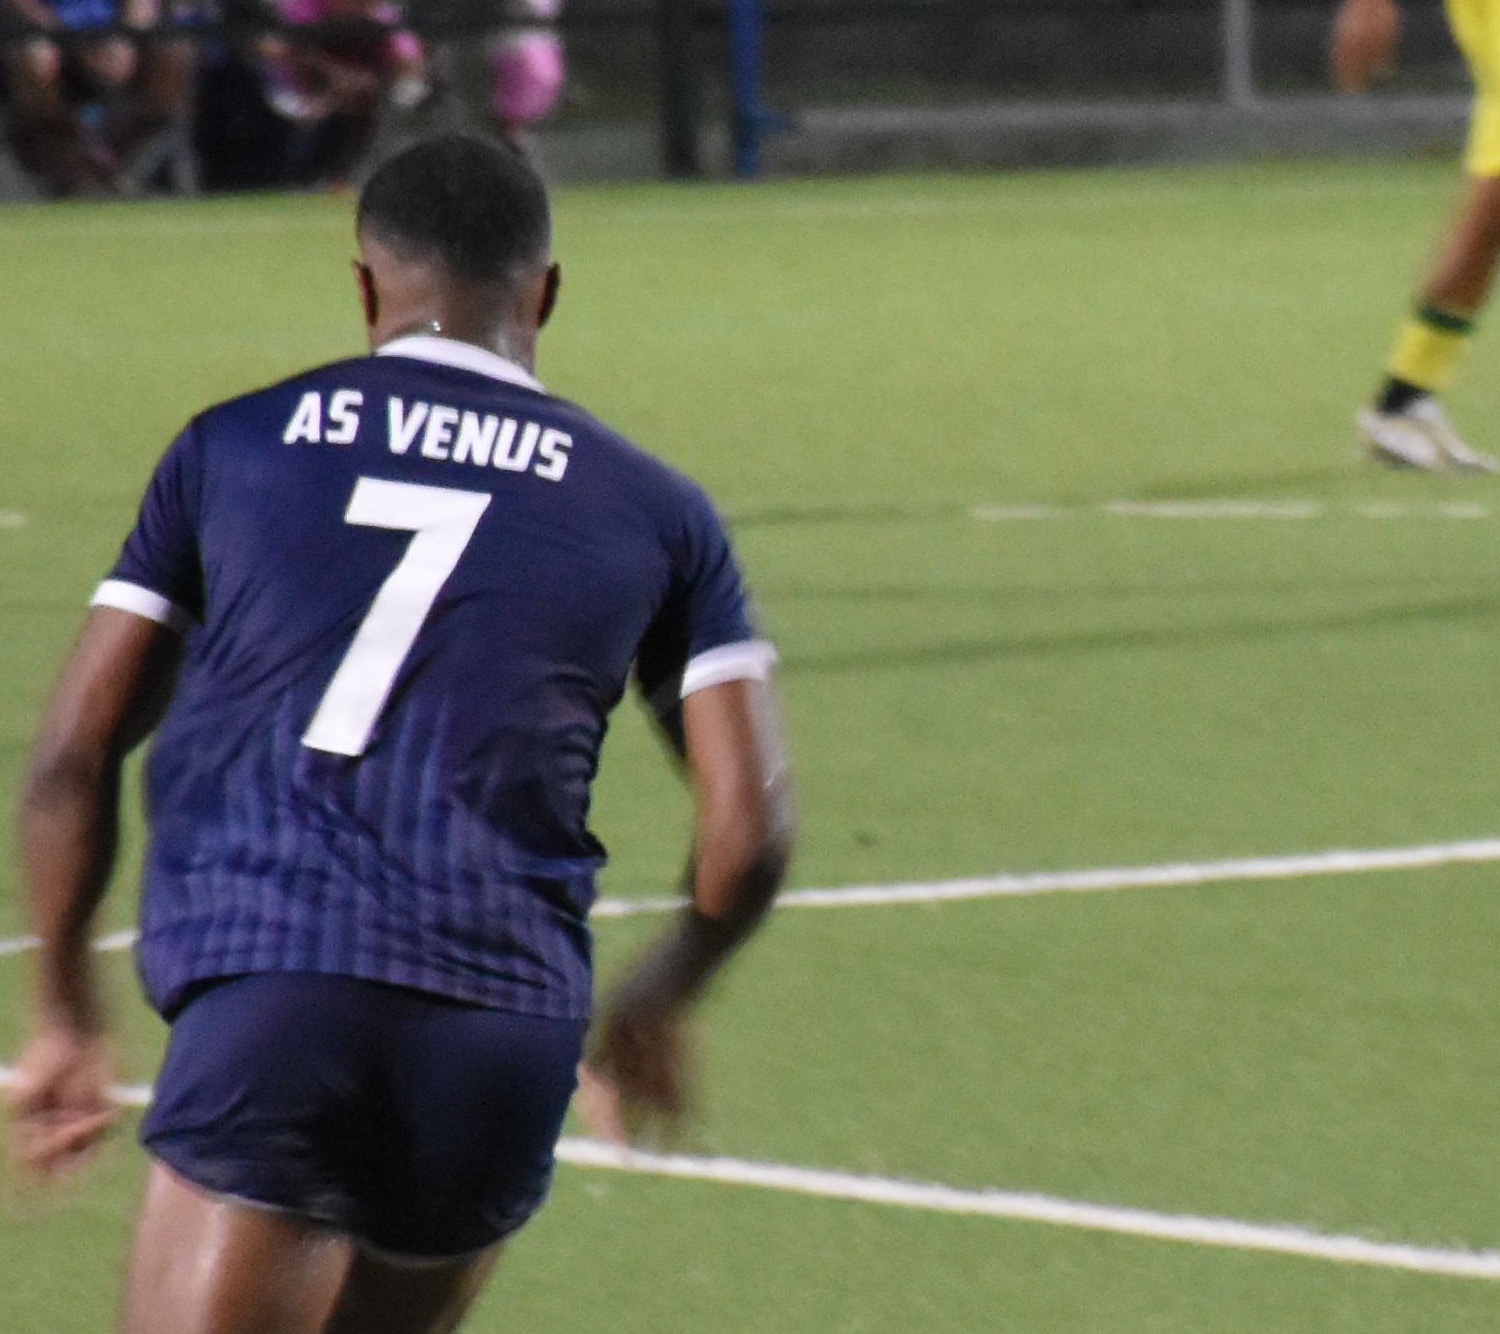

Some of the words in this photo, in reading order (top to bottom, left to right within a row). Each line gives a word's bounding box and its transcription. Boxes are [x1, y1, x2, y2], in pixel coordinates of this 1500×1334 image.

[283, 389, 364, 445] AS
[388, 396, 573, 482] VENUS
[300, 475, 493, 757] 7
